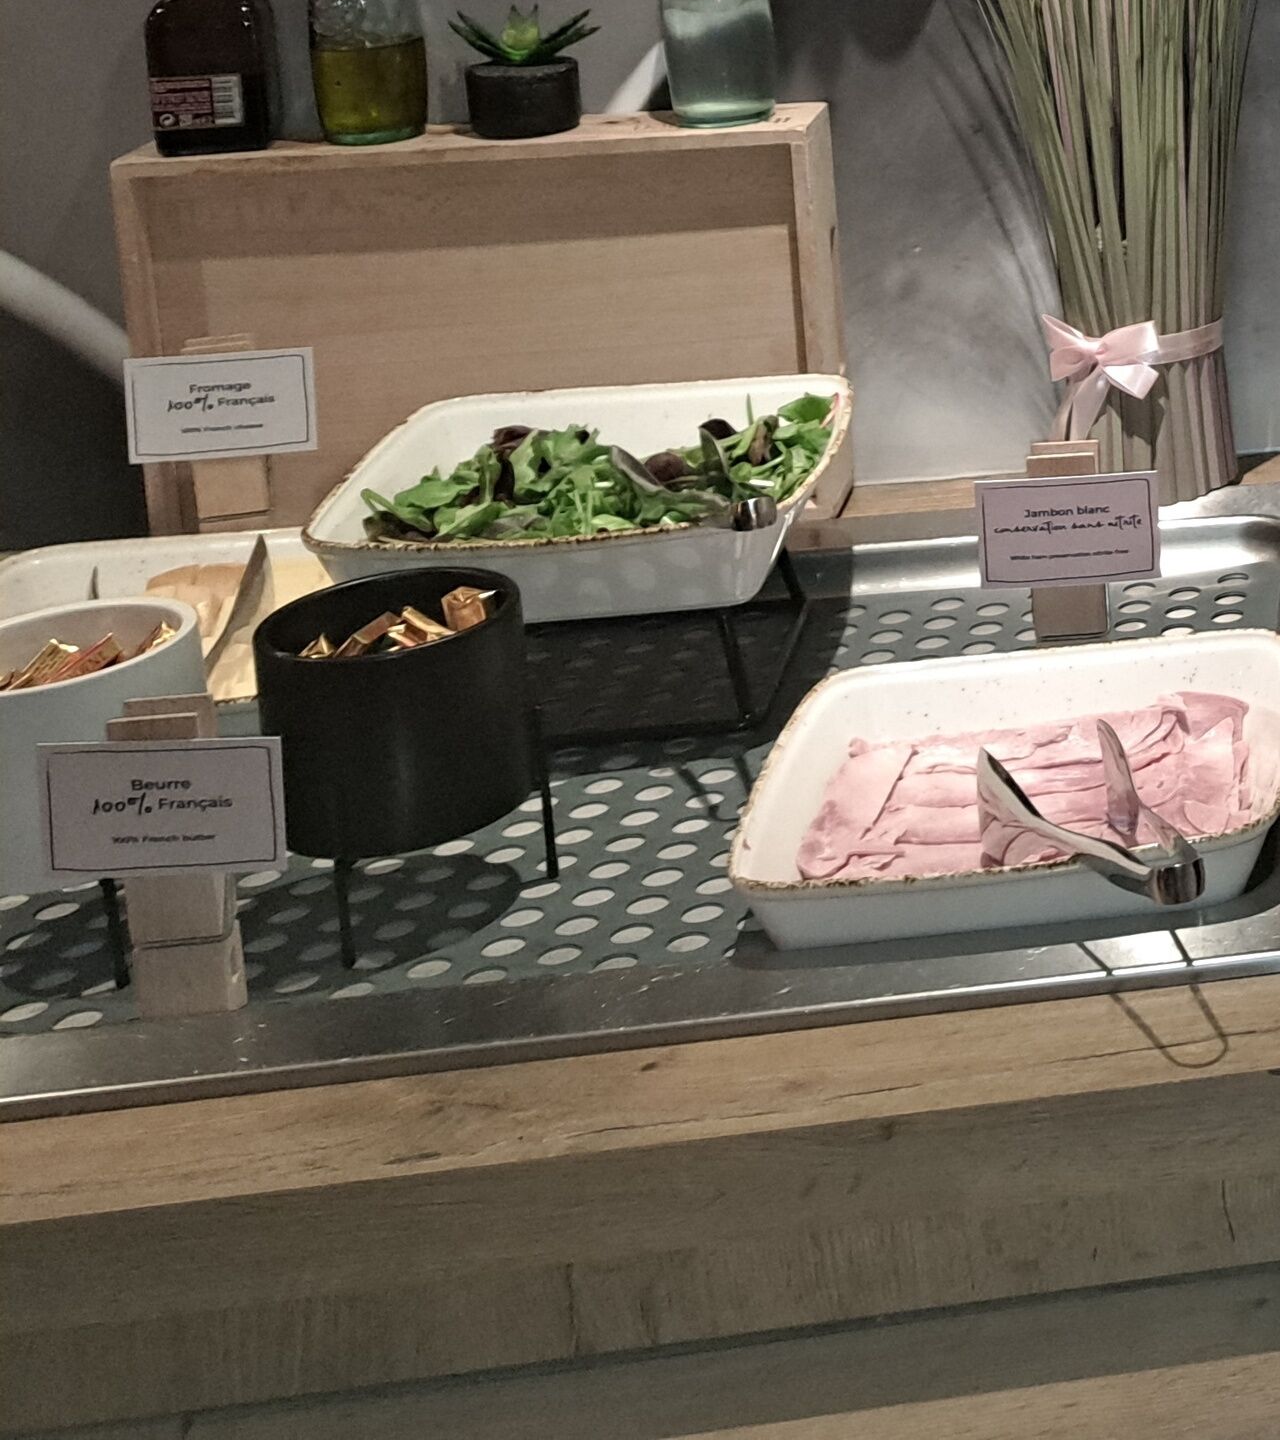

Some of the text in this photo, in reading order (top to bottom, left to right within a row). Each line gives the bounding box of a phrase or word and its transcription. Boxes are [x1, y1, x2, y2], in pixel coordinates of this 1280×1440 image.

[189, 382, 251, 393] Fromage
[217, 395, 275, 407] Français
[1024, 505, 1111, 518] Jambon blanc
[131, 779, 191, 790] Beurre
[92, 792, 233, 815] 100% Français
